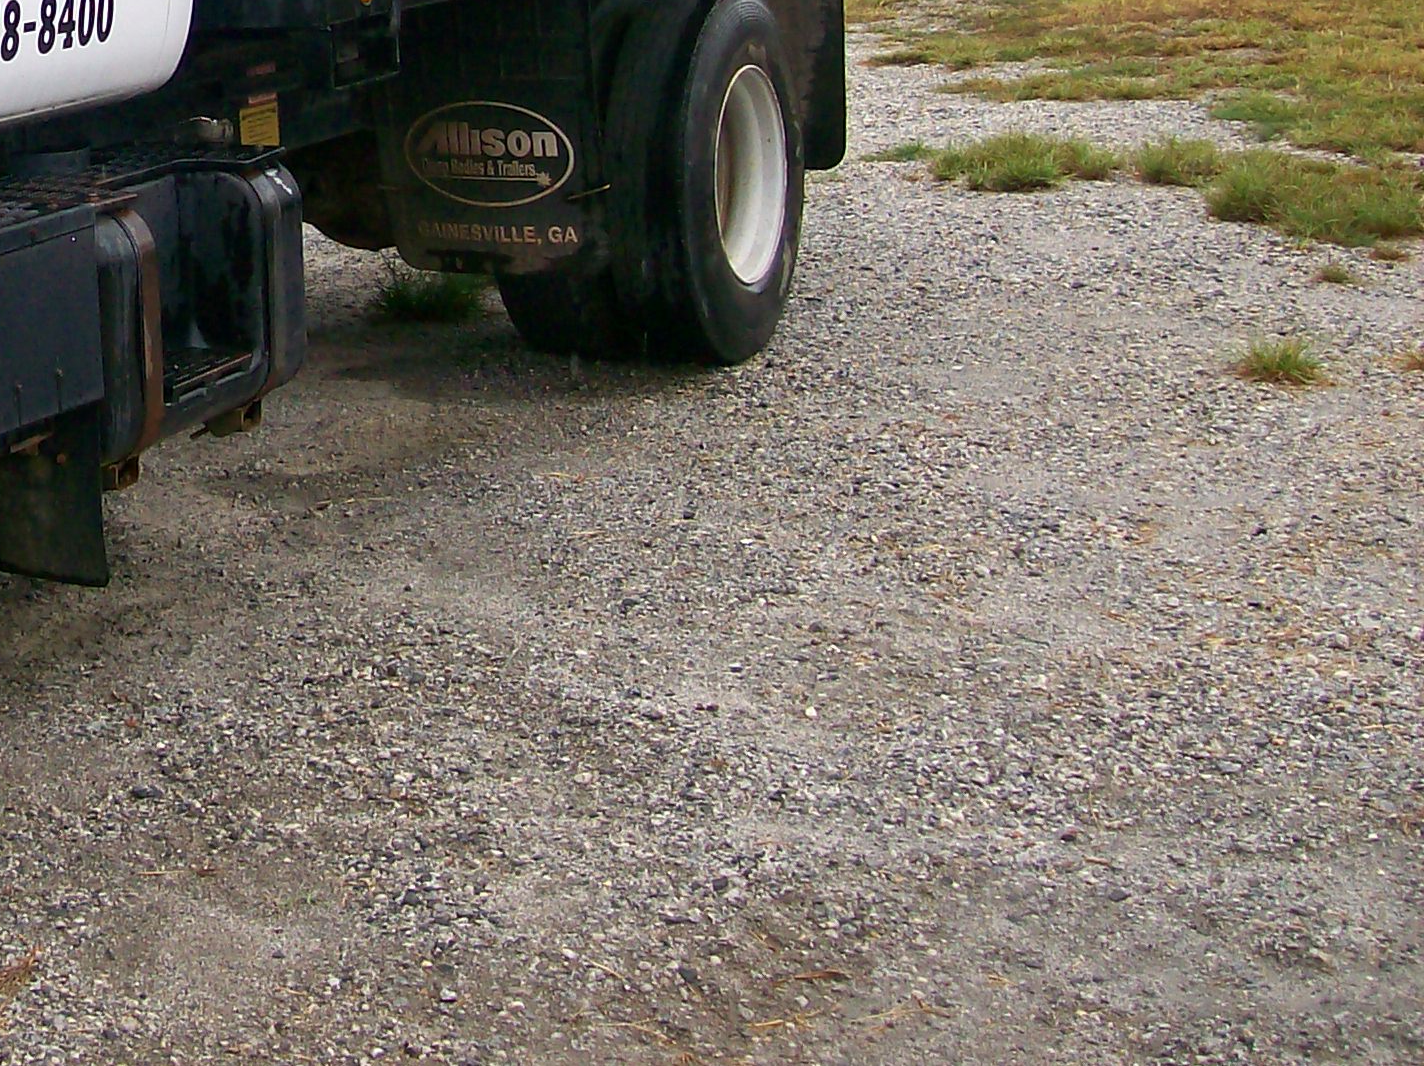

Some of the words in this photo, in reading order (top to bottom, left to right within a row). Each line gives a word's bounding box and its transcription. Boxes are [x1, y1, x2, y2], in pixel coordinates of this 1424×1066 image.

[417, 121, 559, 158] Allison
[487, 160, 495, 176] &
[418, 221, 543, 245] GAINESVILLE,
[548, 225, 578, 243] GA
